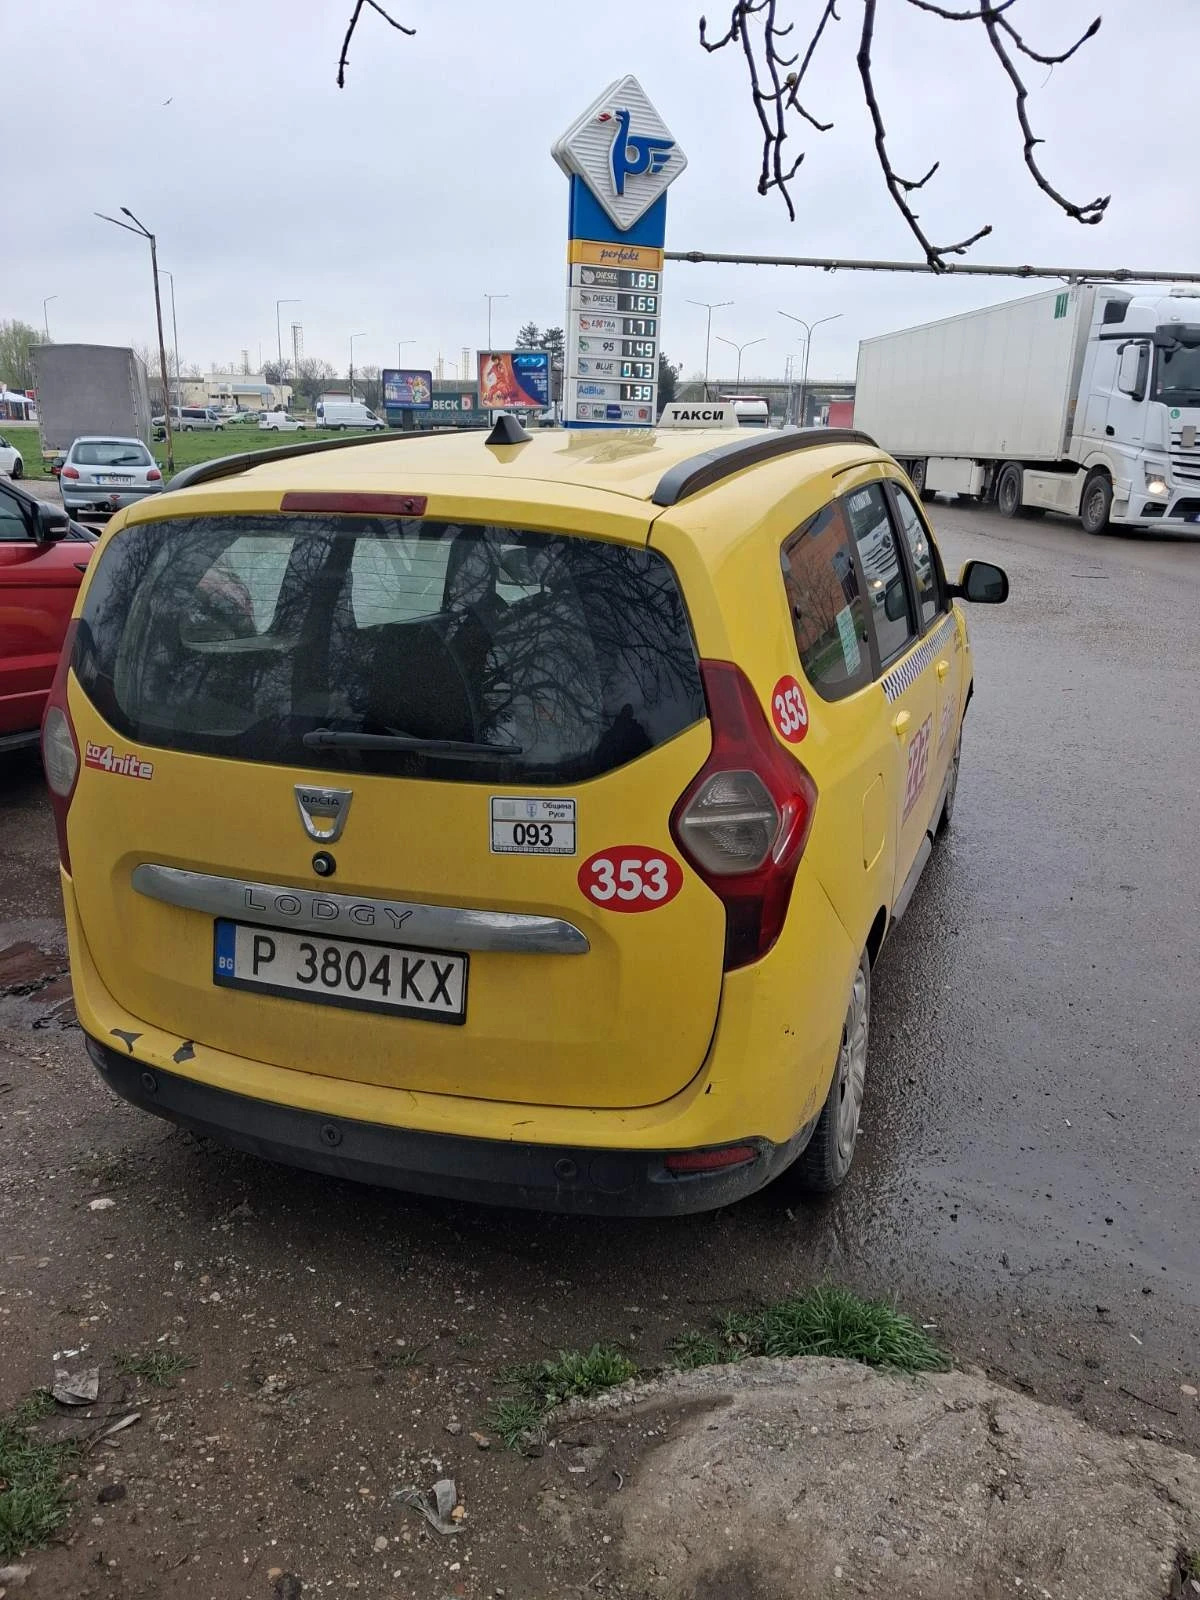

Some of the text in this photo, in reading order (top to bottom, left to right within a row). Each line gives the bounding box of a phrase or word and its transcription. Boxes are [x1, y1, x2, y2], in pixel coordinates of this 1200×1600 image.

[595, 271, 656, 288] DIESEL 1.89
[592, 294, 617, 304] DIESEL
[630, 295, 655, 312] 1.69
[629, 319, 654, 335] 1.71
[602, 341, 653, 357] 95 1.49
[595, 362, 652, 378] BLUE 0.73
[577, 385, 651, 400] AdBlue 1.39
[432, 400, 459, 410] BECK
[672, 410, 724, 420] ТАКСИ
[775, 686, 807, 736] 353
[302, 795, 340, 806] DACIA
[542, 802, 572, 810] Община
[548, 811, 566, 819] Русе
[513, 823, 554, 847] 093
[590, 858, 669, 900] 353
[244, 888, 413, 930] LODGY
[218, 956, 234, 970] BG
